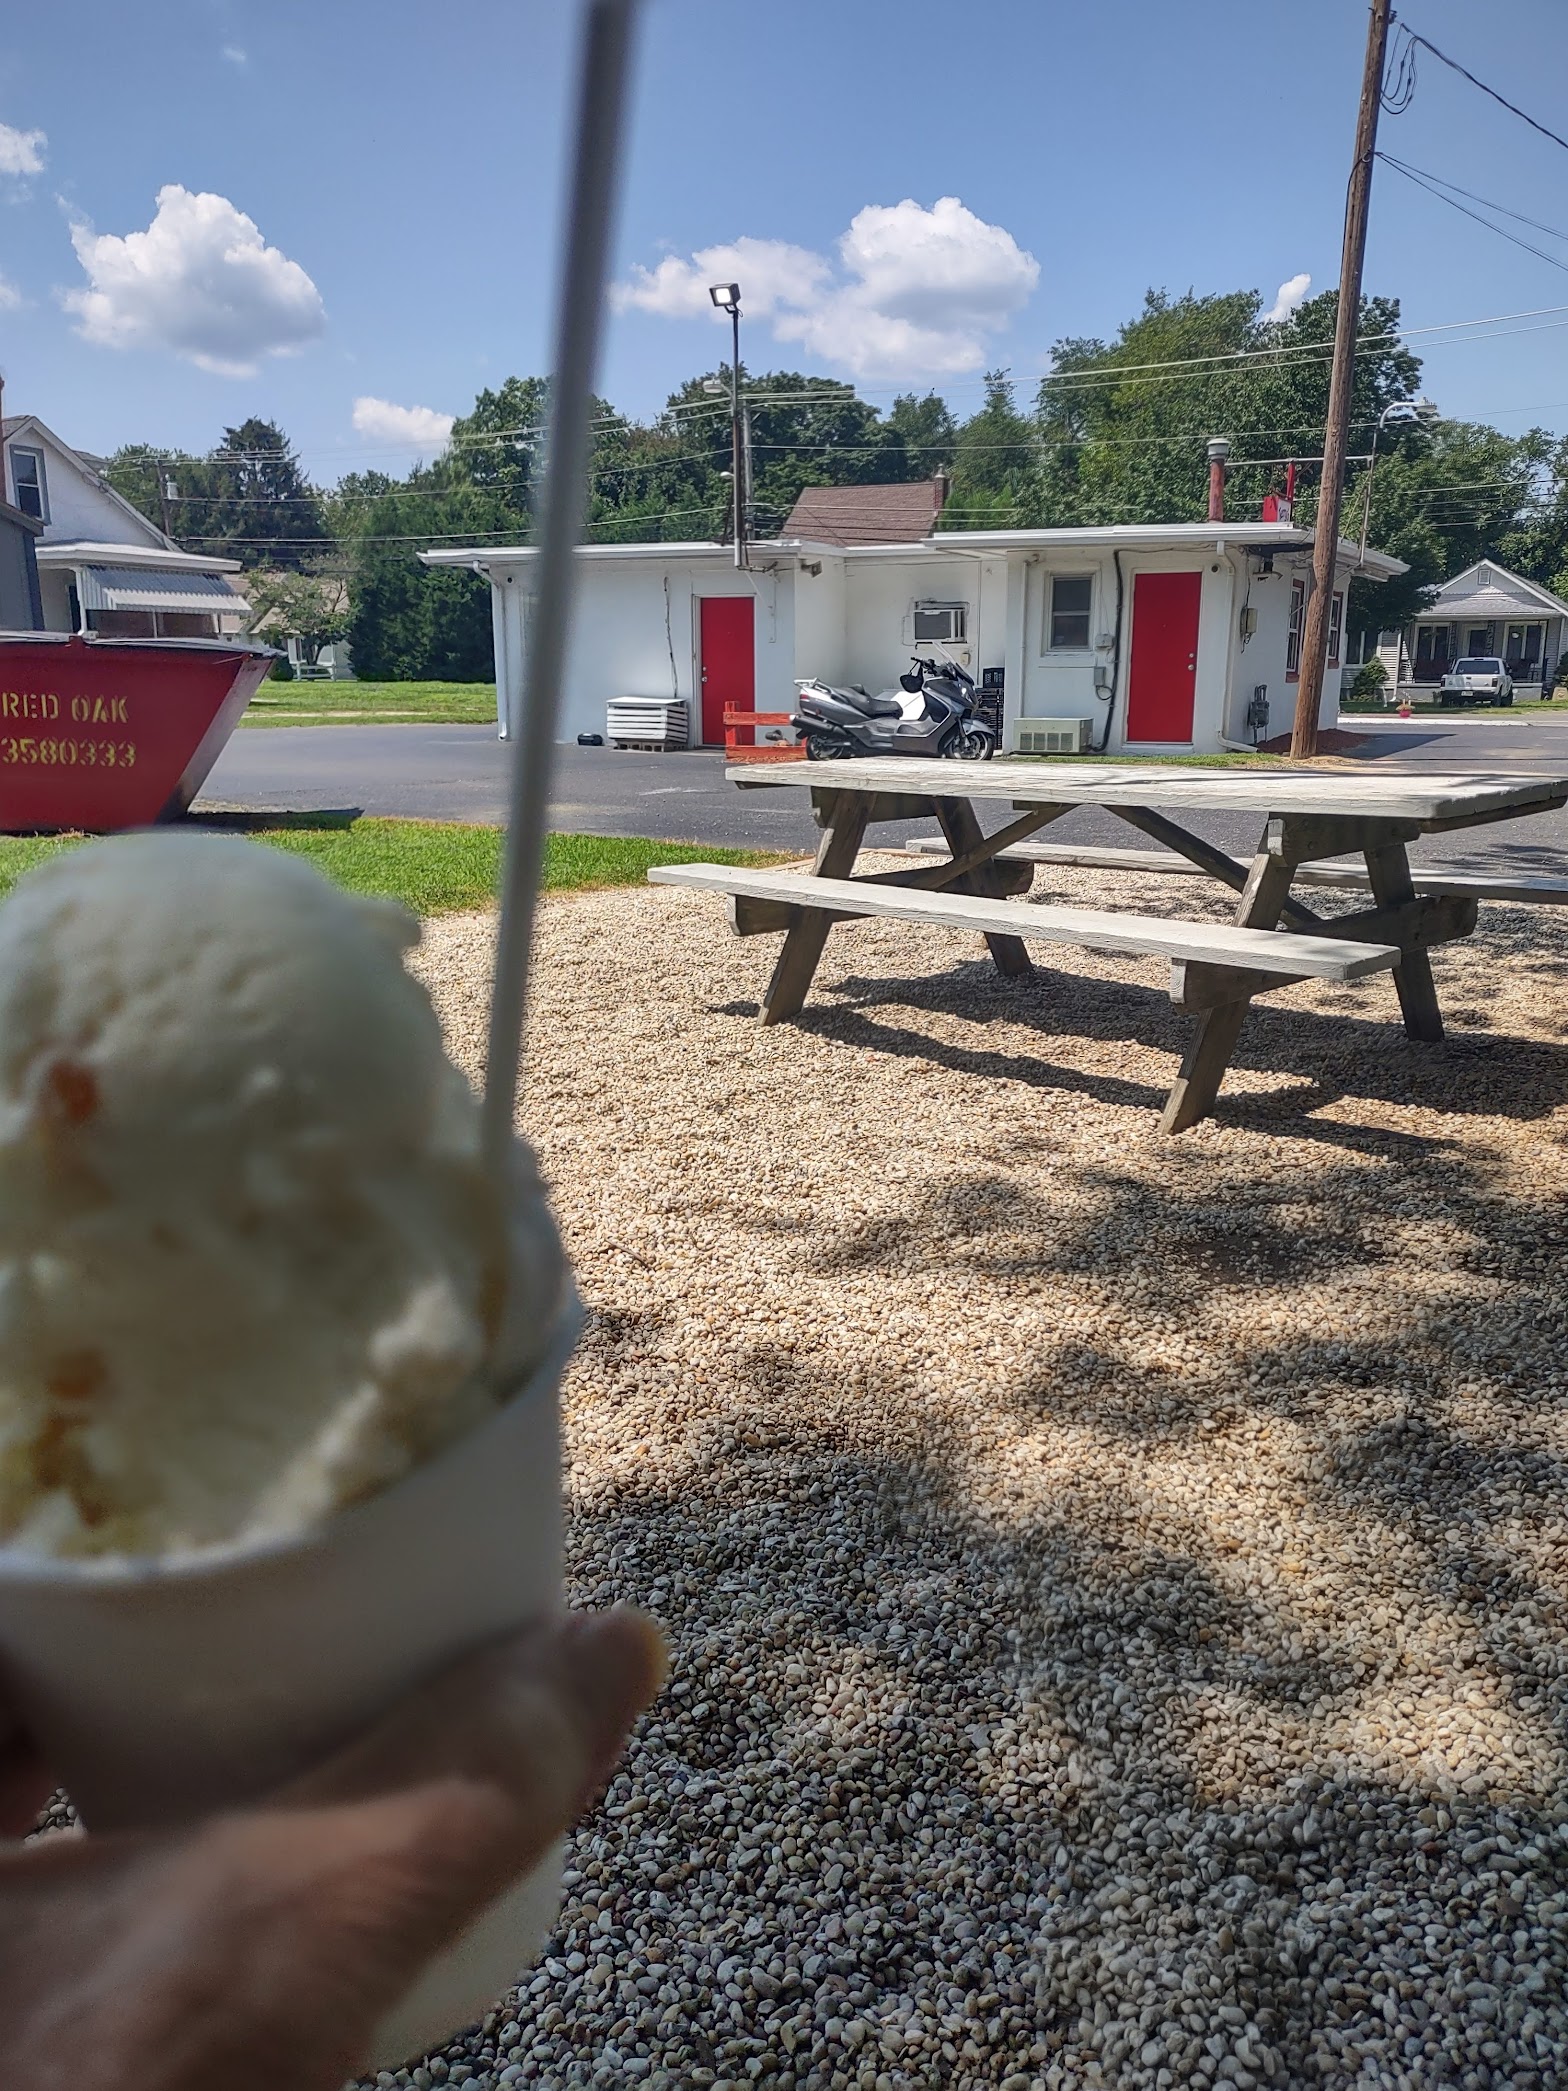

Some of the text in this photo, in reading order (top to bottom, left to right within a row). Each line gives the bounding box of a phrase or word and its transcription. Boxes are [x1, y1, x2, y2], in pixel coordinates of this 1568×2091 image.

[2, 692, 129, 723] RED OAK
[1, 737, 136, 767] 3580333
